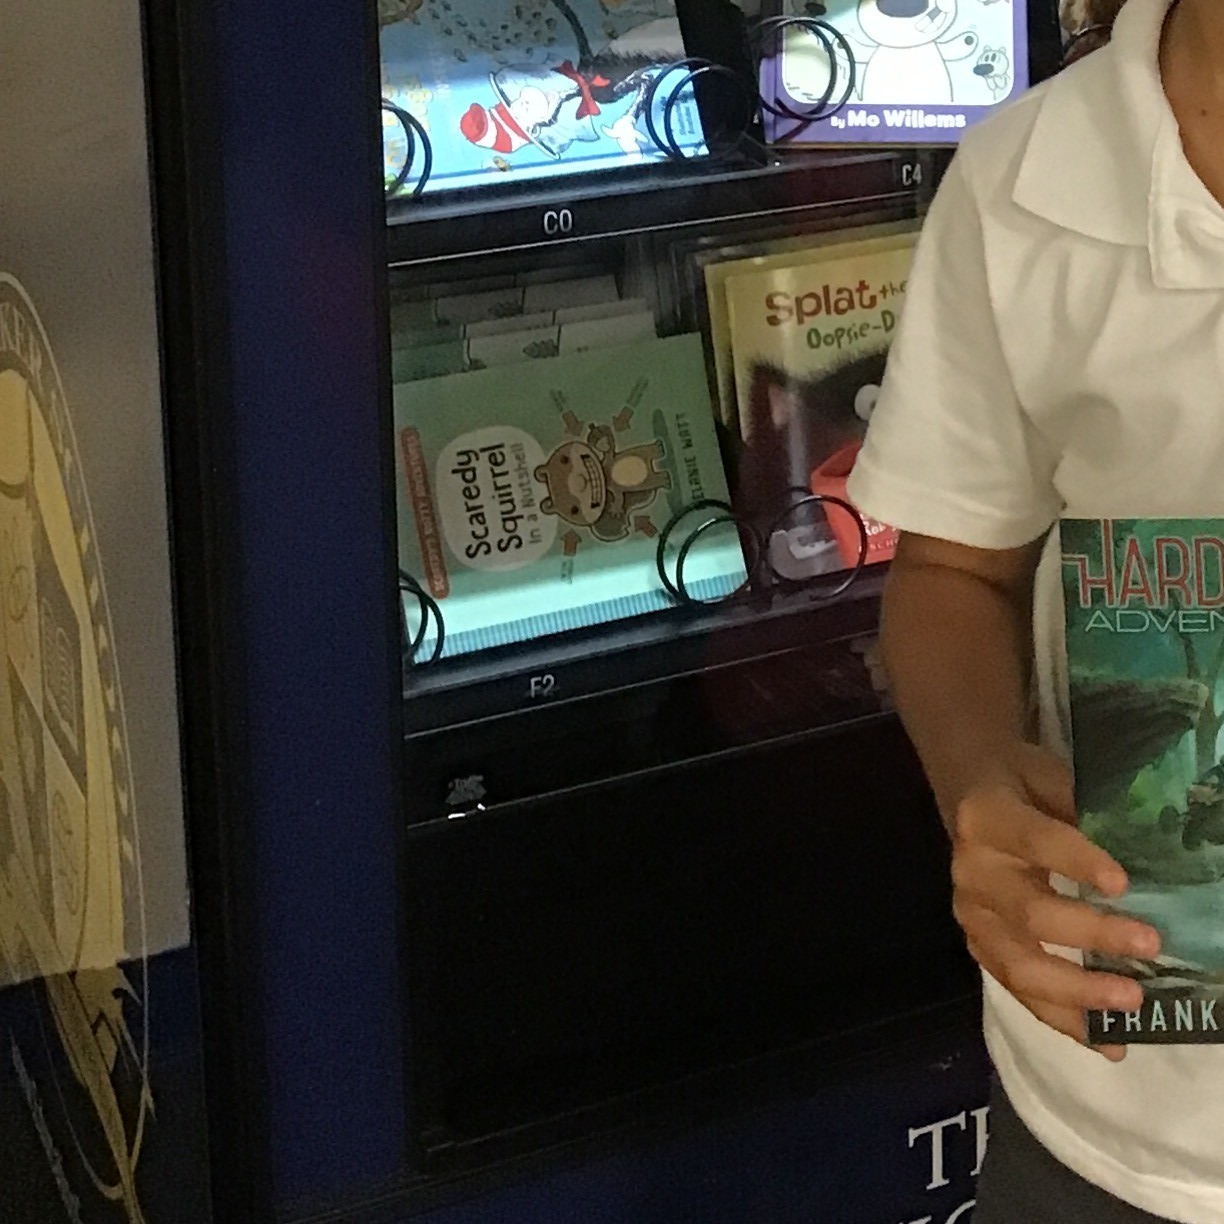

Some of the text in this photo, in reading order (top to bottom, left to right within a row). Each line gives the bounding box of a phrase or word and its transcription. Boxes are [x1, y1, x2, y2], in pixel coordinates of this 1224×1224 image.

[831, 109, 966, 130] By Mo Willems
[901, 165, 922, 186] C4
[543, 209, 573, 234] C0
[765, 280, 878, 326] Splat
[806, 310, 902, 349] Oopsie-D
[510, 442, 536, 508] Nutshell
[684, 456, 705, 502] ELANIE
[451, 449, 491, 559] Scaredy
[479, 443, 524, 552] Squirrel
[527, 513, 538, 522] a
